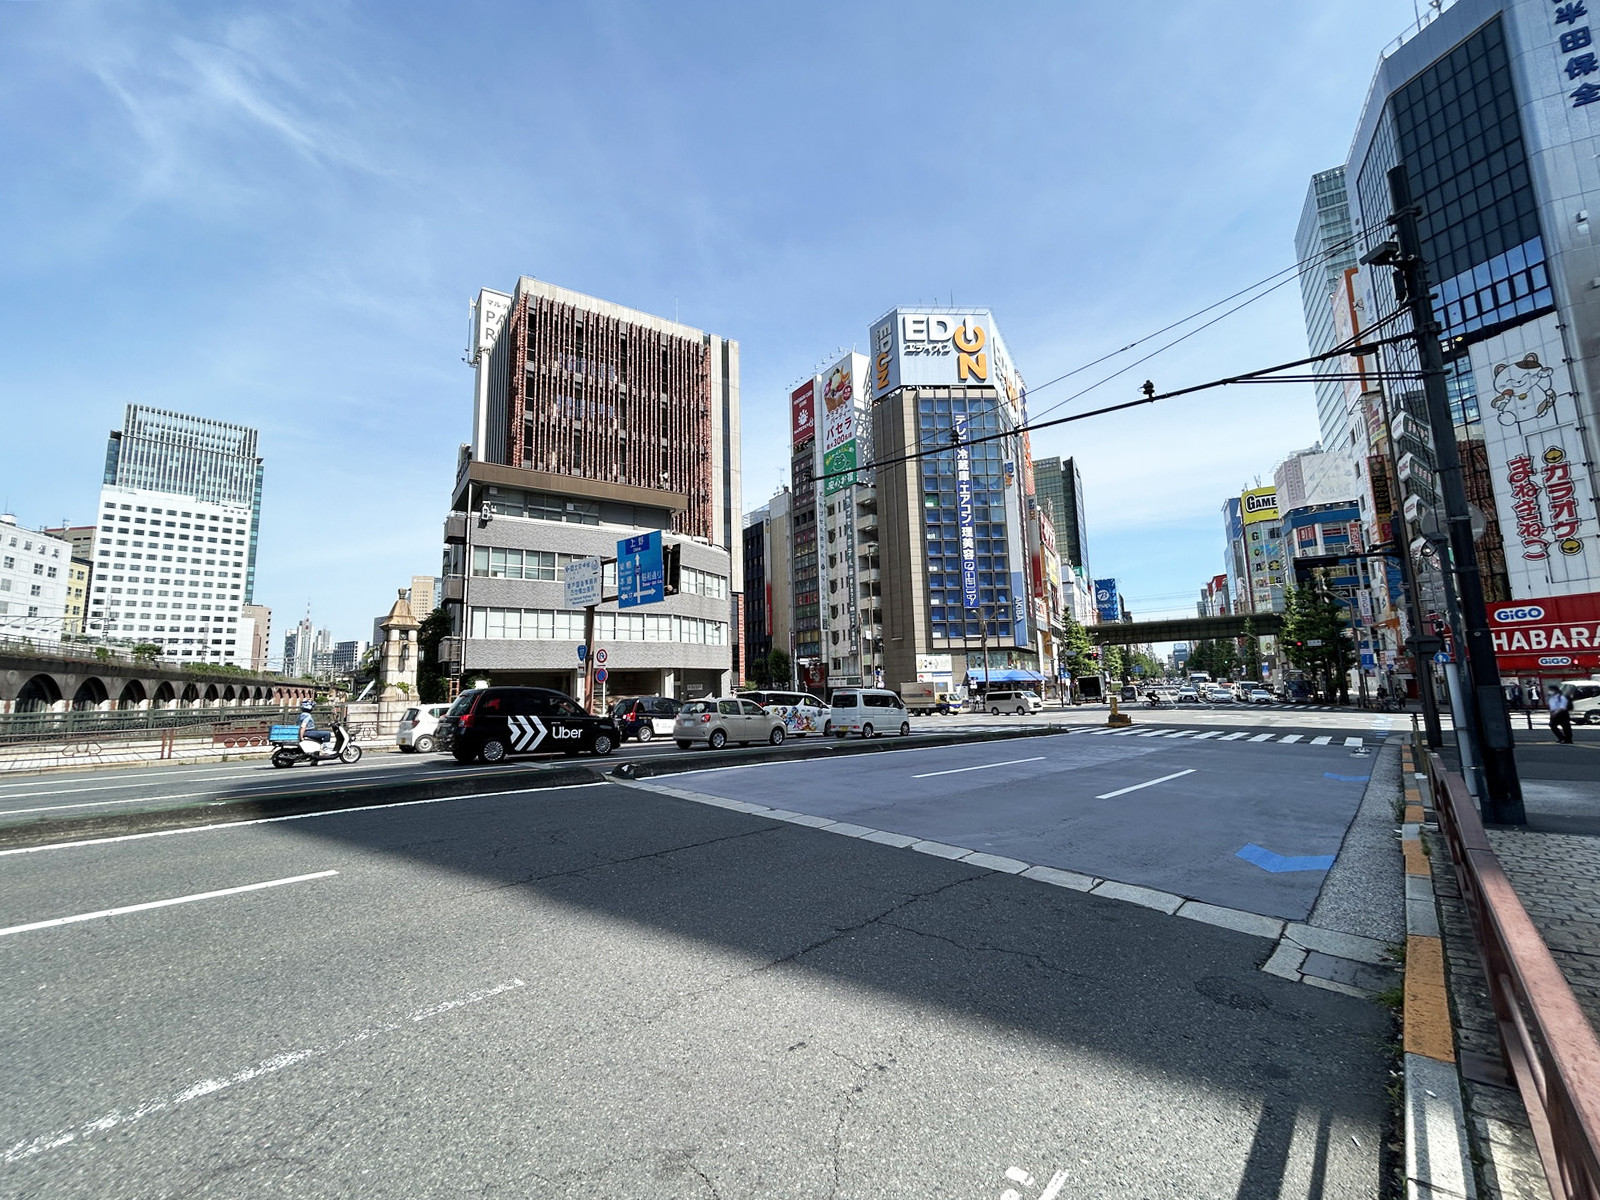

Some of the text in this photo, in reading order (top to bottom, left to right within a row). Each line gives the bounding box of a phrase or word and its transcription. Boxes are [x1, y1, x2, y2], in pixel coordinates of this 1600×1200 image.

[1552, 0, 1600, 107] 半田保全
[902, 314, 988, 383] EDION
[826, 416, 852, 440] パセラ
[1509, 456, 1549, 559] まねきねこ
[1543, 463, 1579, 539] カラオケ
[630, 536, 644, 548] 上野
[1013, 596, 1025, 622] AKIBA
[1496, 607, 1542, 621] GiGO
[1540, 656, 1570, 666] GiGO
[551, 725, 583, 739] Uber
